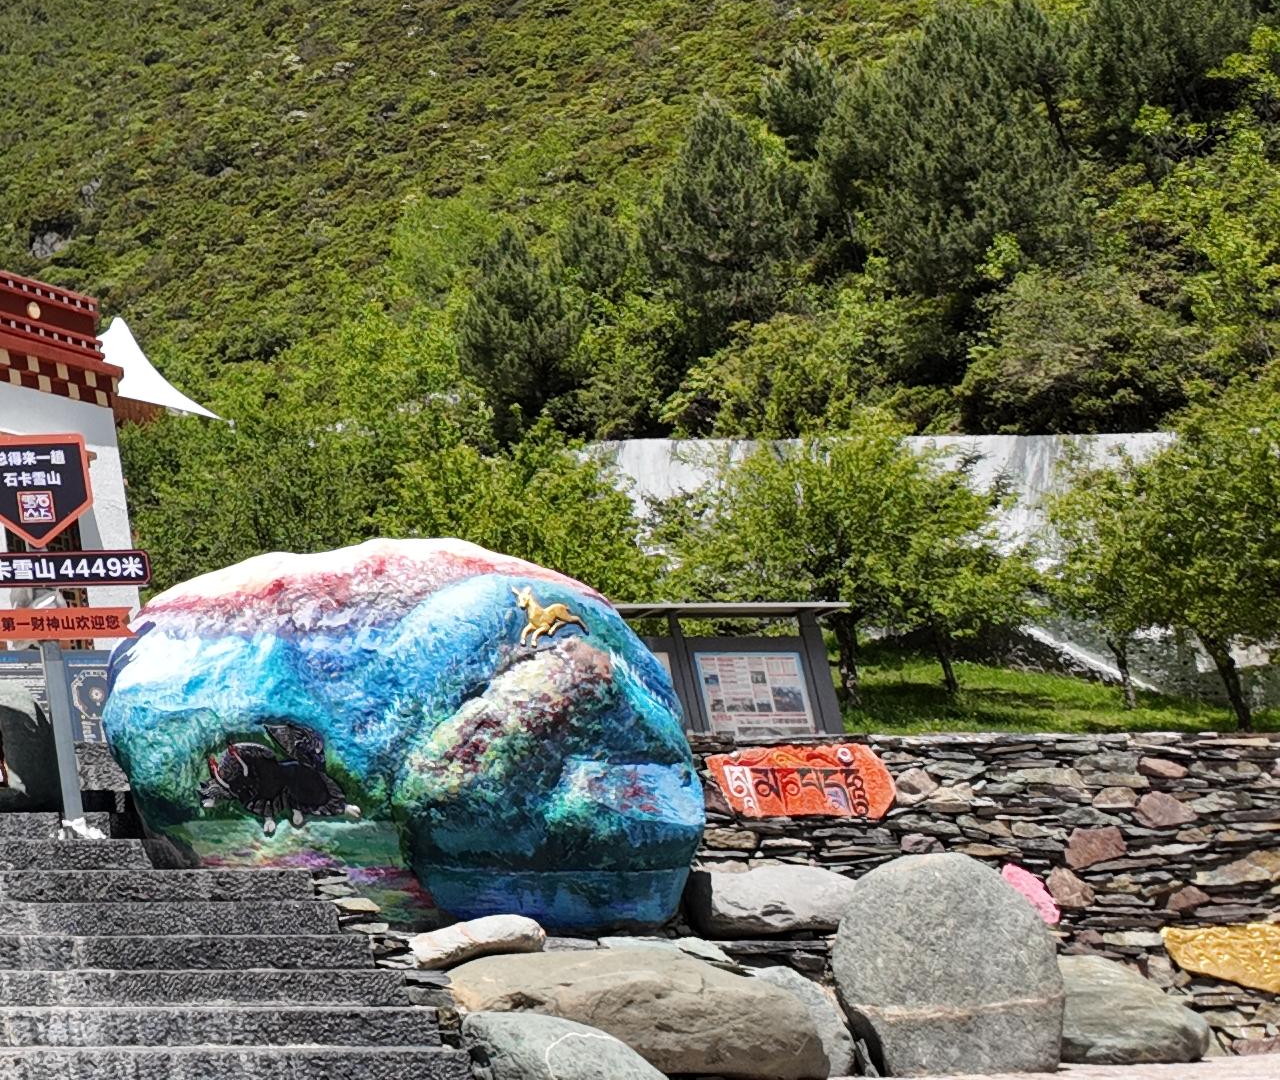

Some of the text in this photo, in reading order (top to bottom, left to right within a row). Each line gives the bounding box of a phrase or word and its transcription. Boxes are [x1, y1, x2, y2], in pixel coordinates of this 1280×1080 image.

[3, 470, 61, 487] 石卡雪山
[59, 556, 144, 578] 4449米
